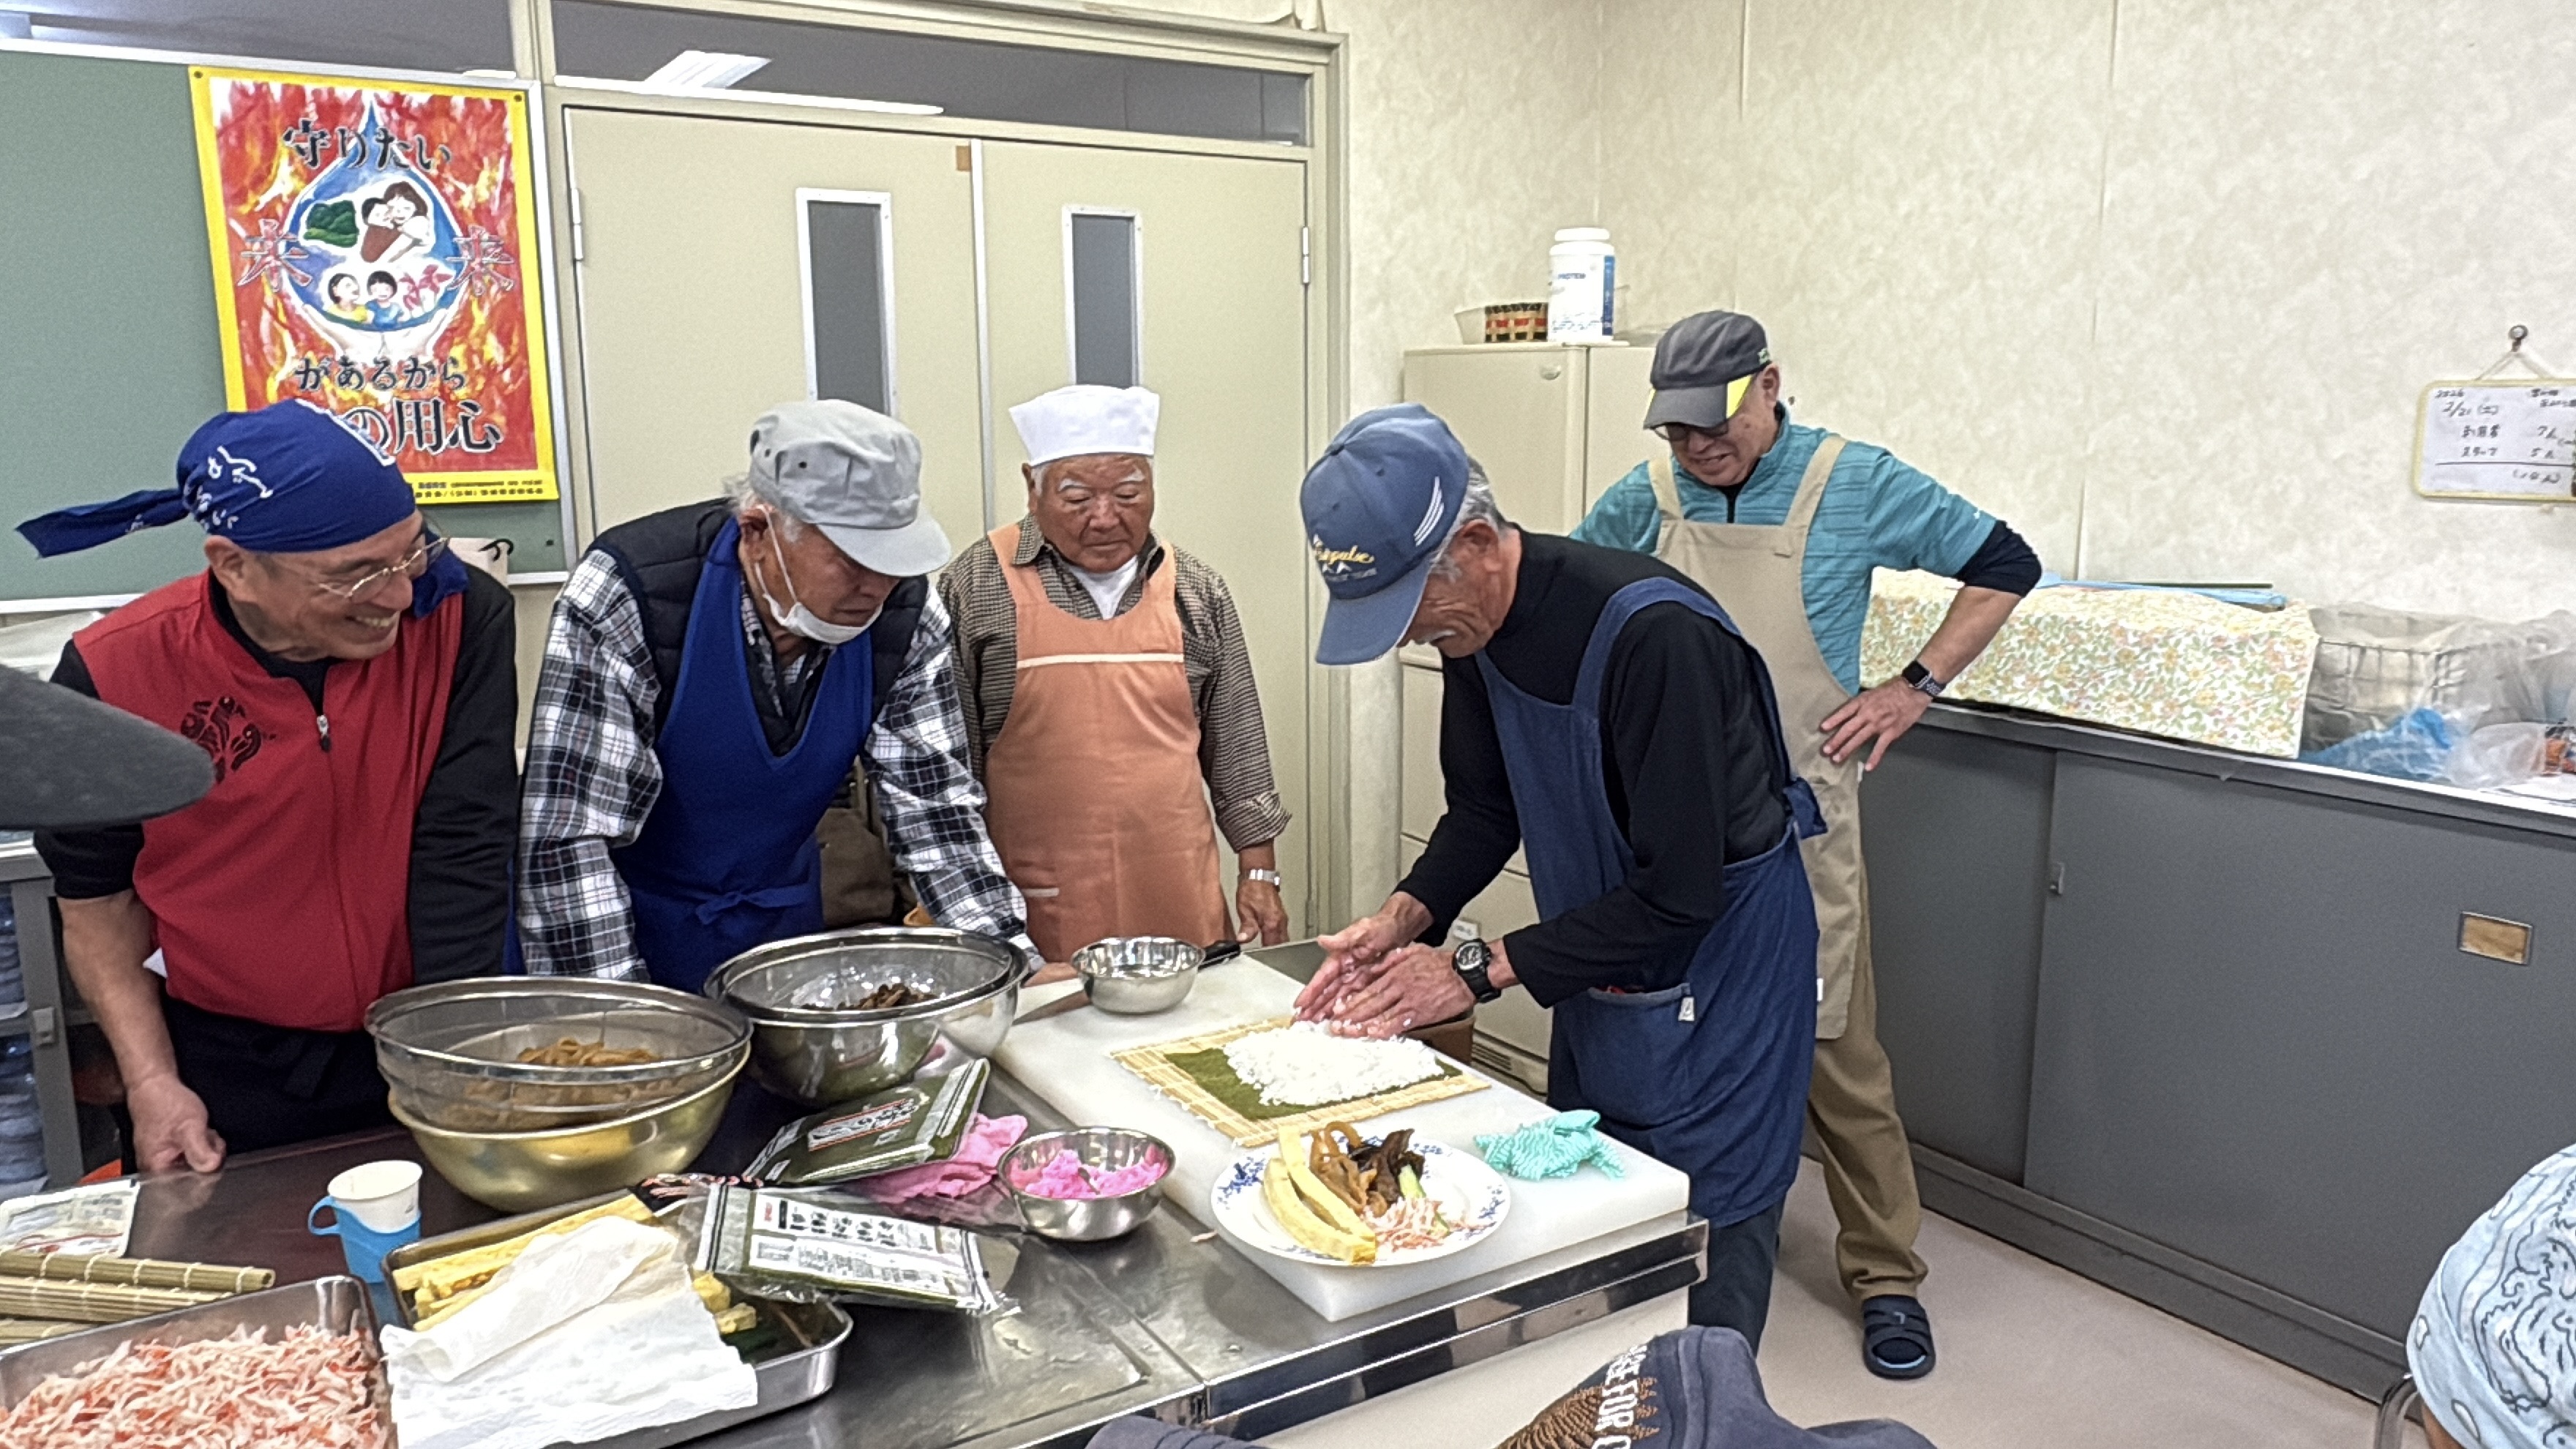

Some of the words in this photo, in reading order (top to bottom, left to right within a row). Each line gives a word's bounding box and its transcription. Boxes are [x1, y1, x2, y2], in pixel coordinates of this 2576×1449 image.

[283, 119, 452, 171] 守りたい
[236, 219, 312, 292] 未
[446, 225, 515, 296] 来
[295, 356, 467, 392] があるから
[1595, 1379, 1639, 1431] FOR
